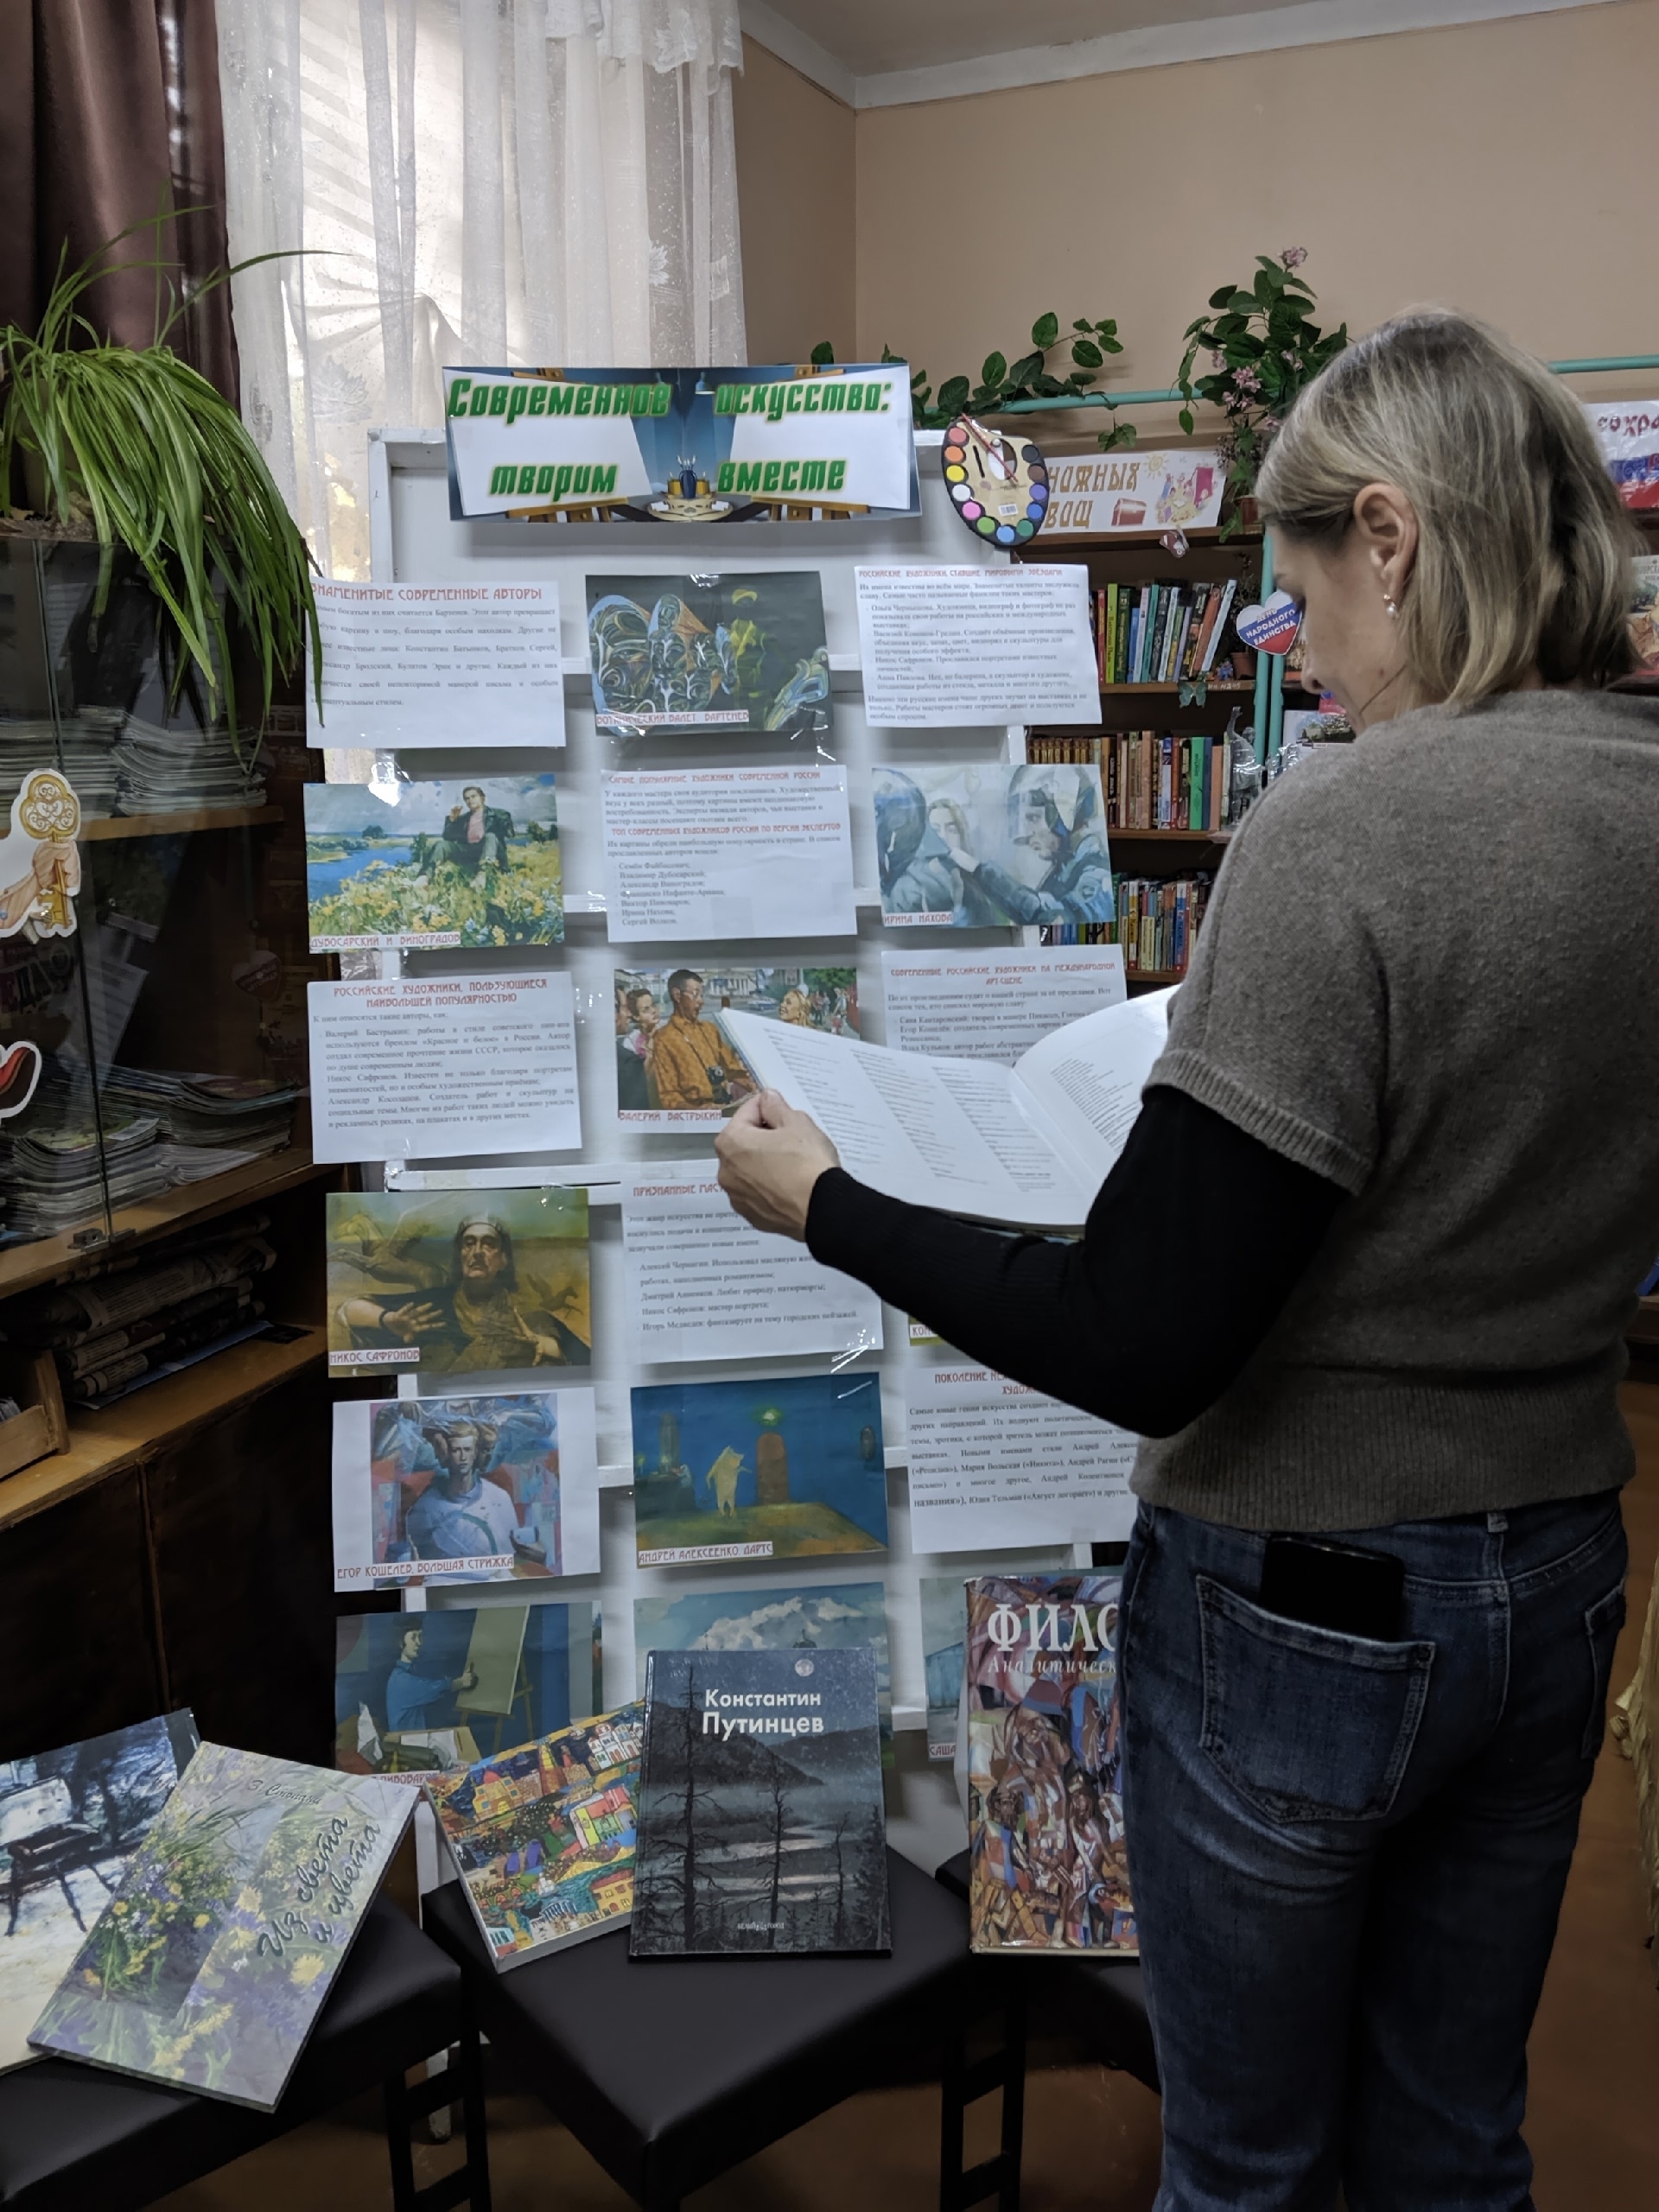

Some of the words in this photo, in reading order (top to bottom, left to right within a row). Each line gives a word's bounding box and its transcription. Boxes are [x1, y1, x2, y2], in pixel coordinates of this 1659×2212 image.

[447, 378, 671, 424] Современное
[715, 382, 893, 422] искусство:
[489, 463, 619, 501] творим
[717, 459, 846, 493] вместе
[311, 583, 394, 601] ЗНАМЕНИТЫЕ
[398, 588, 488, 601] СОВРЕМЕННЫЕ
[493, 588, 542, 600] АВТОРЫ
[1246, 609, 1295, 639] НАРОДНОГО
[1253, 620, 1296, 645] ЕДИНСТВА
[884, 913, 913, 925] ИРИНА
[311, 936, 379, 948] ДУБОСАРСКИЙ
[386, 937, 392, 945] И
[334, 985, 396, 996] РОССИЙСКИЕ
[469, 978, 547, 992] ПОЛЬЗУЮЩИЕСЯ
[366, 995, 432, 1008] НАИБОЛЬШЕЙ
[435, 993, 518, 1006] ПОПУЛЯРНОСТЬЮ
[330, 1351, 363, 1363] НИКОС
[366, 1350, 420, 1362] САФРОНОВ
[935, 1370, 988, 1384] ПОКОЛЕНИЕ
[639, 1550, 676, 1563] АНДРЕЙ
[744, 1543, 772, 1554] ДАРТС
[337, 1567, 361, 1580] ЕГОР
[417, 1560, 464, 1573] БОЛЬШАЯ
[467, 1556, 514, 1569] СТРИЖКА
[705, 1688, 821, 1707] Константин
[702, 1711, 824, 1742] Путинцев
[257, 1911, 309, 1957] Из
